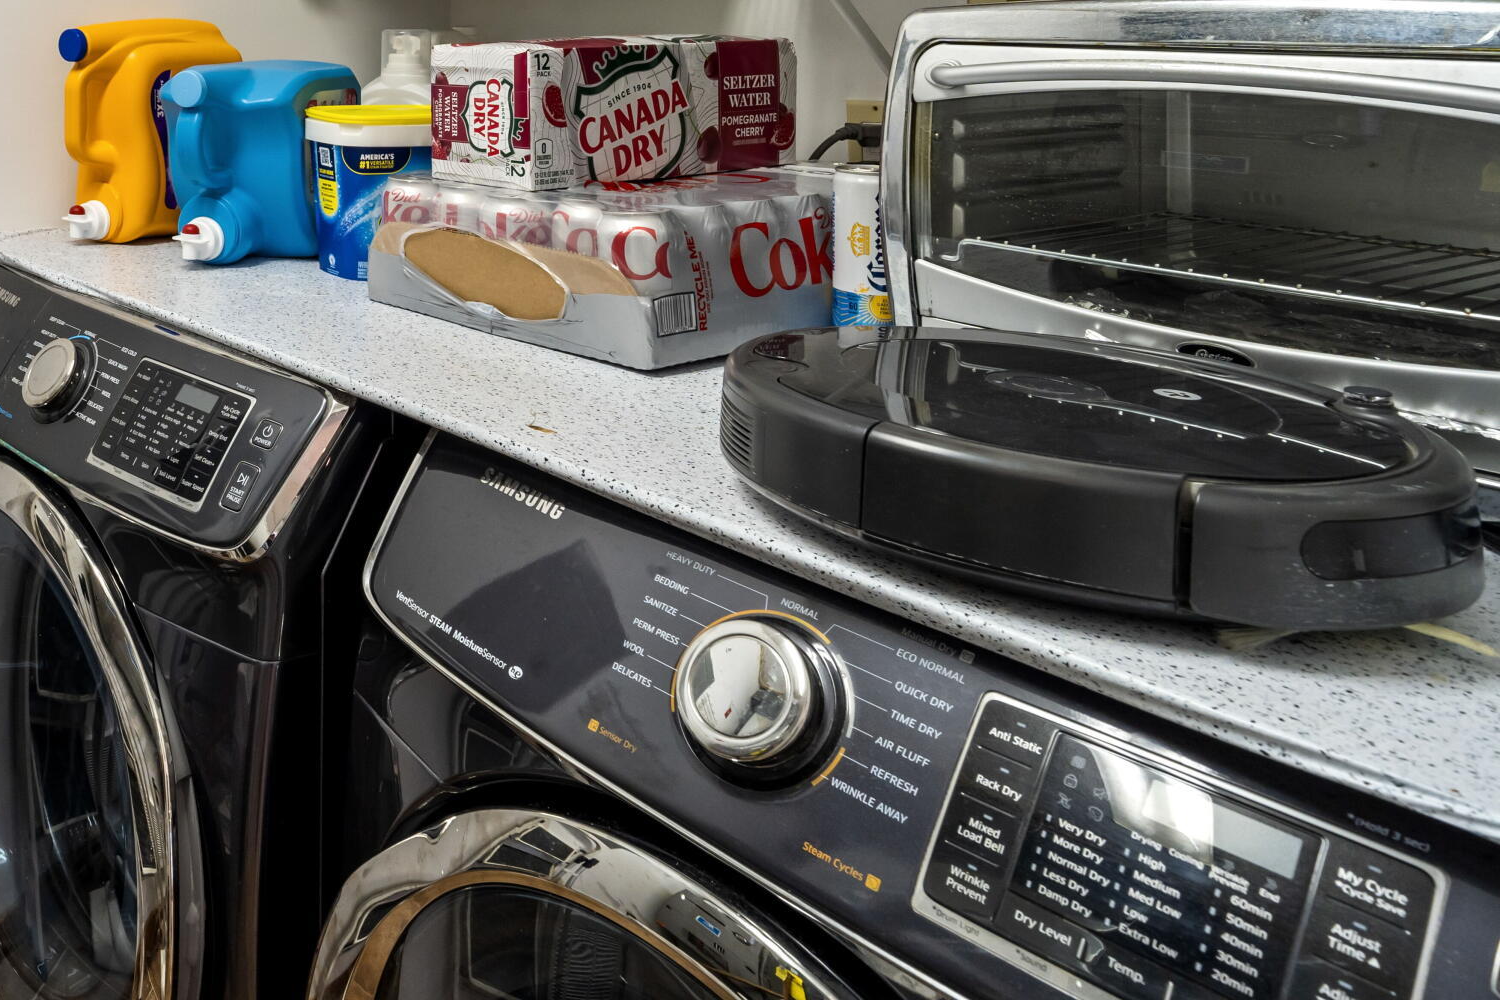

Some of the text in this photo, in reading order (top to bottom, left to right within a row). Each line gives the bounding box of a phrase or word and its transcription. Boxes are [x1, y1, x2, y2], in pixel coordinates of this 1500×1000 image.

[534, 53, 551, 71] 12
[608, 82, 652, 108] SINCE 1904
[723, 74, 775, 90] SELTZER
[728, 92, 771, 108] WATER
[474, 98, 486, 138] DRY
[486, 78, 501, 158] CANADA
[579, 80, 688, 155] CANADA
[722, 112, 777, 126] POMEGRANATE
[735, 126, 765, 138] CHERRY
[360, 161, 369, 169] #1
[612, 123, 665, 178] DRY
[511, 157, 526, 177] 12
[691, 261, 708, 331] RECYCLE
[254, 436, 272, 446] POWER
[226, 493, 241, 504] PAUSE
[230, 486, 245, 497] START
[480, 467, 566, 520] SAMSUNG
[666, 549, 717, 576] HEAVY DUTY
[654, 573, 690, 595] BEDDING
[643, 594, 679, 618] SANITIZE
[780, 597, 819, 622] NORMAL
[395, 589, 507, 670] VentSensor STEAM MoistureSensor
[632, 616, 680, 646] PERM PRESS
[623, 639, 646, 658] WOOL
[611, 661, 653, 689] DELICATES
[896, 647, 965, 685] ECO NORMAL
[894, 681, 955, 713] QUICK DRY
[890, 708, 943, 740] TIME DRY
[599, 725, 638, 754] Sensor Dry
[874, 736, 931, 769] AIR FLUFF
[989, 726, 1043, 756] Anti Static
[870, 764, 920, 797] REFRESH
[975, 773, 1023, 803] Rack Dry
[830, 776, 910, 825] WRINKLE AWAY
[957, 826, 1005, 856] Load Bell
[968, 816, 1002, 839] Mixed
[1058, 817, 1107, 848] Very Dry
[802, 840, 866, 883] Steam Cycles
[1052, 834, 1104, 866] More Dry
[1137, 852, 1167, 873] High
[950, 865, 991, 892] Wrinkle
[1042, 867, 1090, 898] Less Dry
[1047, 850, 1111, 889] Normal Dry
[1132, 869, 1181, 900] Medium
[946, 876, 987, 905] Prevent
[1037, 884, 1093, 919] Damp Dry
[1258, 886, 1281, 904] End
[1337, 866, 1409, 907] My Cycle
[1122, 904, 1149, 925] Low
[1127, 886, 1183, 920] Med Low
[1229, 893, 1273, 923] 60min
[1375, 897, 1407, 919] Save
[1014, 909, 1072, 947] Dry Level
[1118, 921, 1179, 959] Extra Low
[1224, 911, 1269, 941] 50min
[1330, 921, 1382, 955] Adjust
[1219, 930, 1264, 960] 40min
[1327, 934, 1366, 962] Time
[1106, 955, 1146, 986] Temp.
[1214, 948, 1259, 979] 30min
[1210, 967, 1255, 998] 20min
